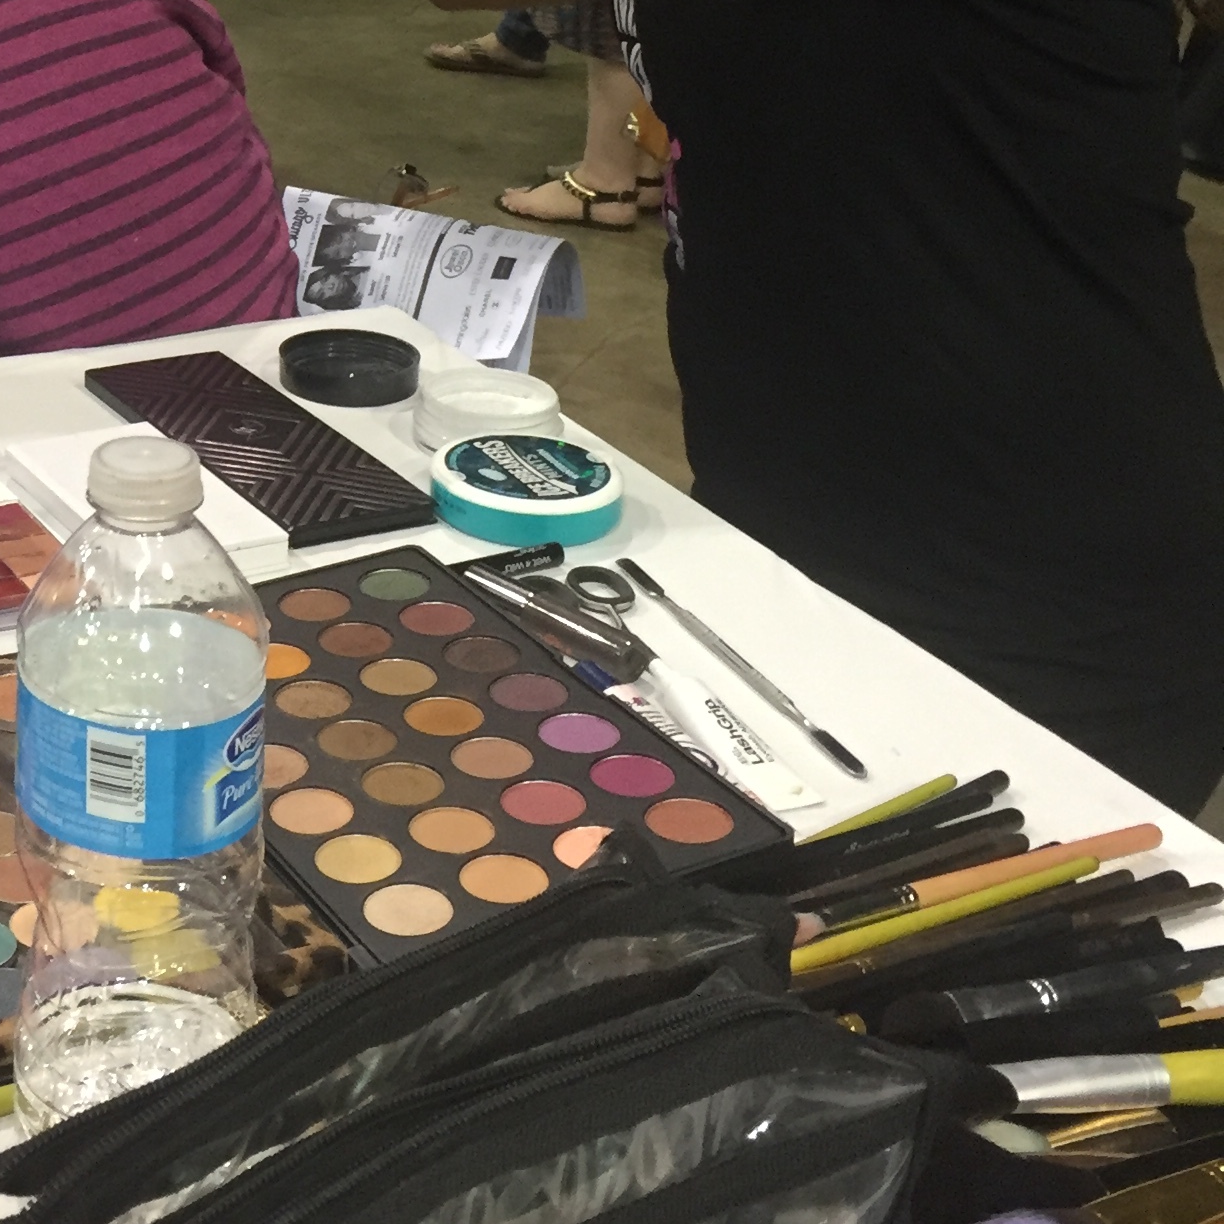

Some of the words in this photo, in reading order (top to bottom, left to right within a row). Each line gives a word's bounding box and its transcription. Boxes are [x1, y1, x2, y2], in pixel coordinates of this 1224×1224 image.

[473, 440, 545, 484] BREAKERS
[523, 453, 563, 480] MINTS
[527, 480, 569, 497] ICE
[704, 698, 765, 765] LashGrip
